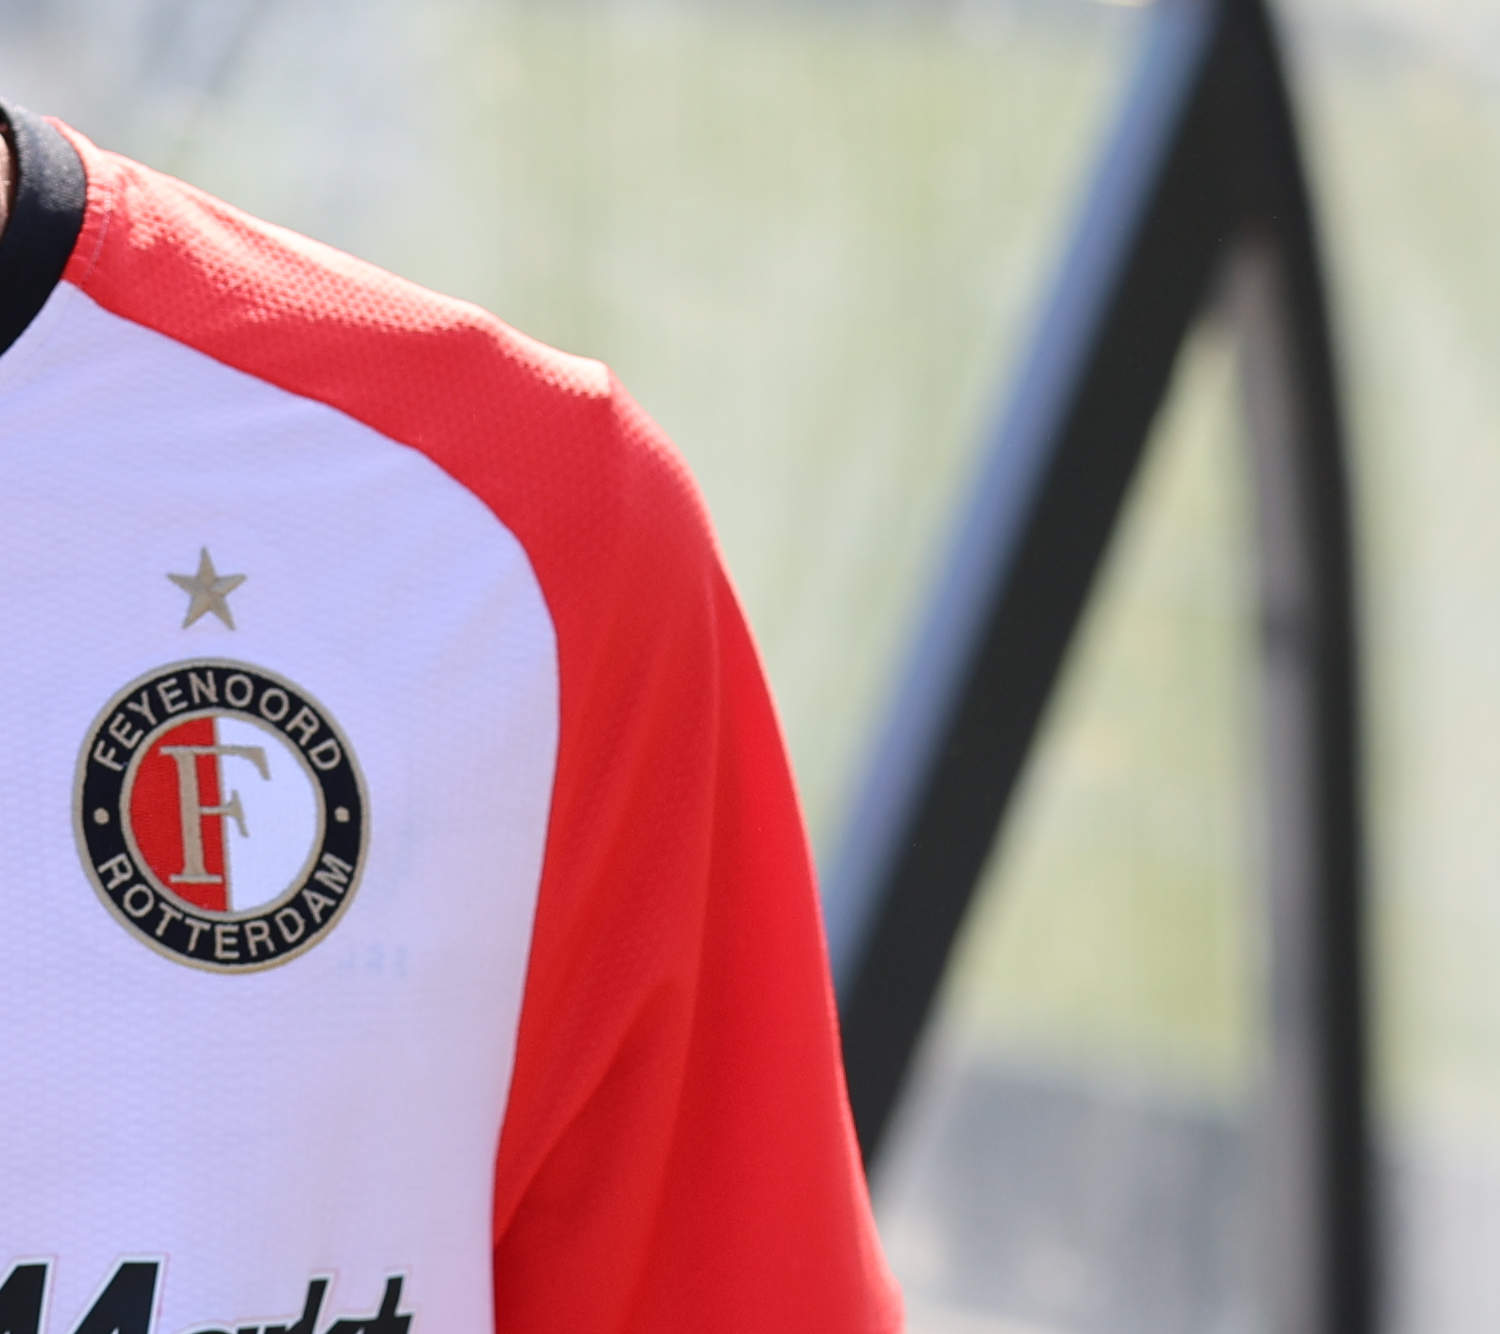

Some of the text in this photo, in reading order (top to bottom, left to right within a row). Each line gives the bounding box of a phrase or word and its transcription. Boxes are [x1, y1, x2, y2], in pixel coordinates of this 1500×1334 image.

[93, 670, 342, 772] FEYENOORD
[159, 745, 271, 883] F
[97, 851, 353, 960] ROTTERDAM
